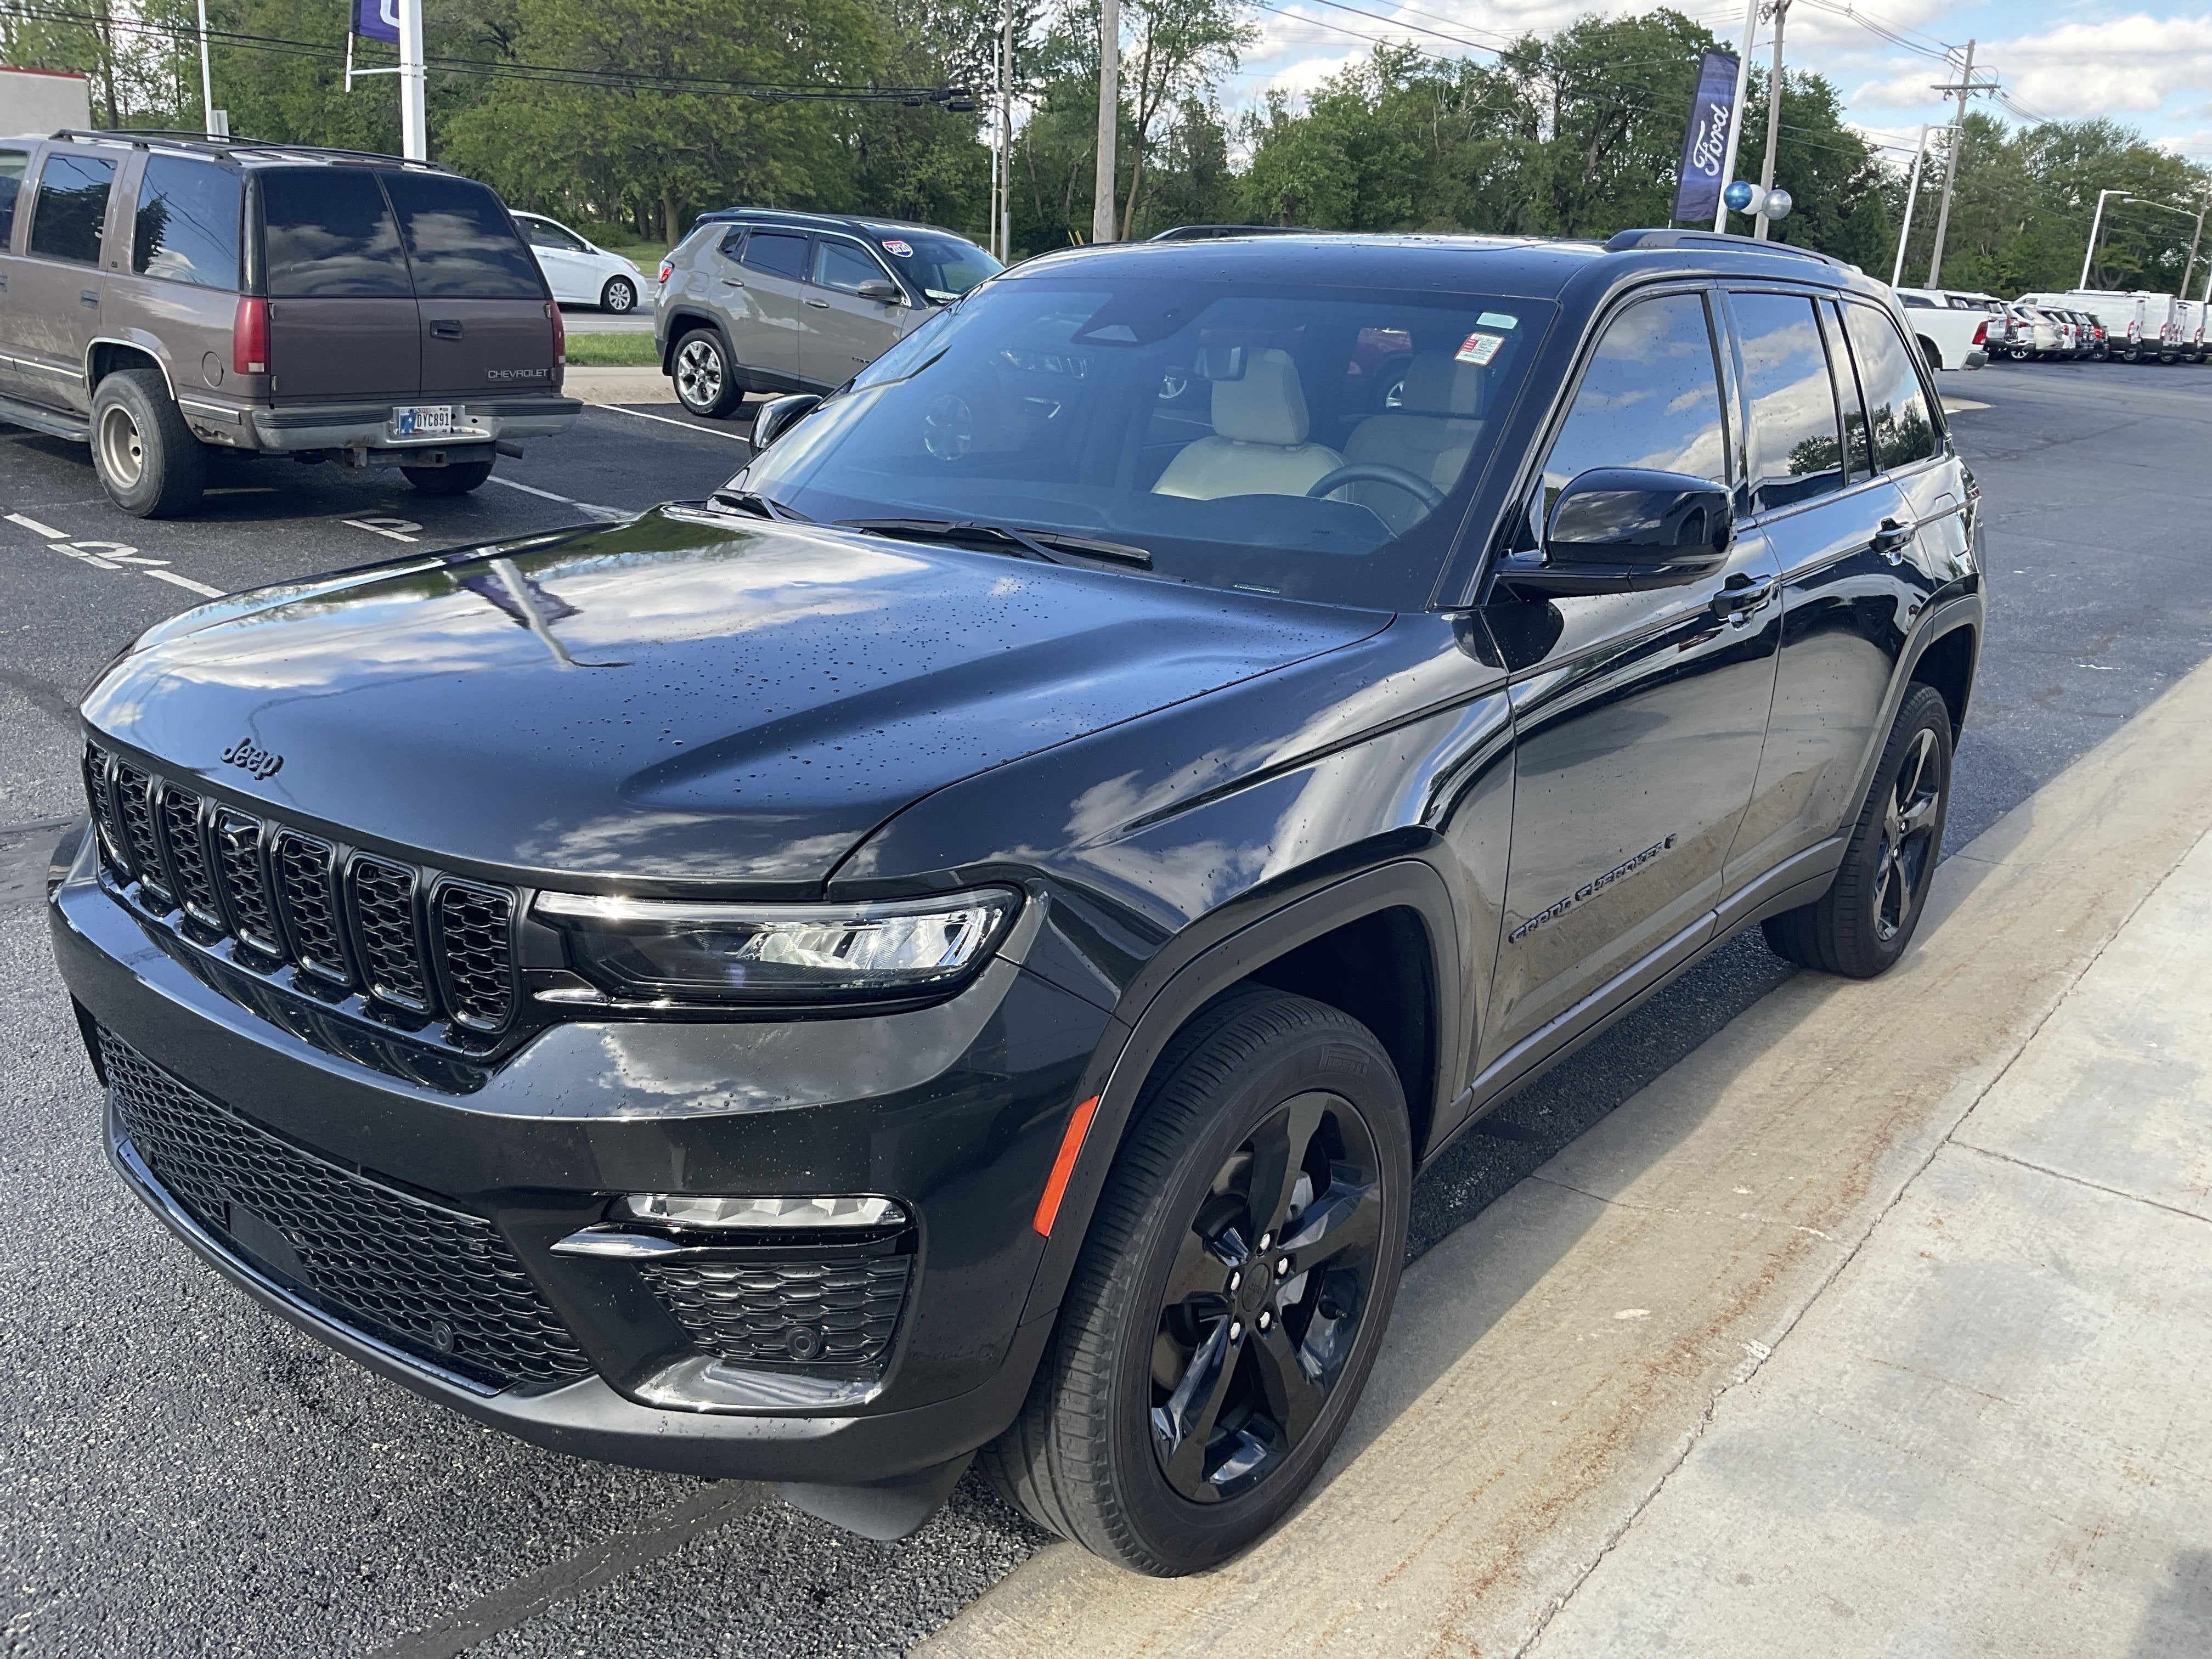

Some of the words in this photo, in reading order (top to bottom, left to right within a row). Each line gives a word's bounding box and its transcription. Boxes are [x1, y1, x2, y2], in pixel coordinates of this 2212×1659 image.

[1694, 103, 1729, 176] Ford
[889, 244, 909, 253] 2020
[488, 369, 548, 379] CHEVROLET
[417, 413, 449, 427] DYC891
[219, 736, 284, 781] Jeep
[1508, 896, 1572, 944] GRAND
